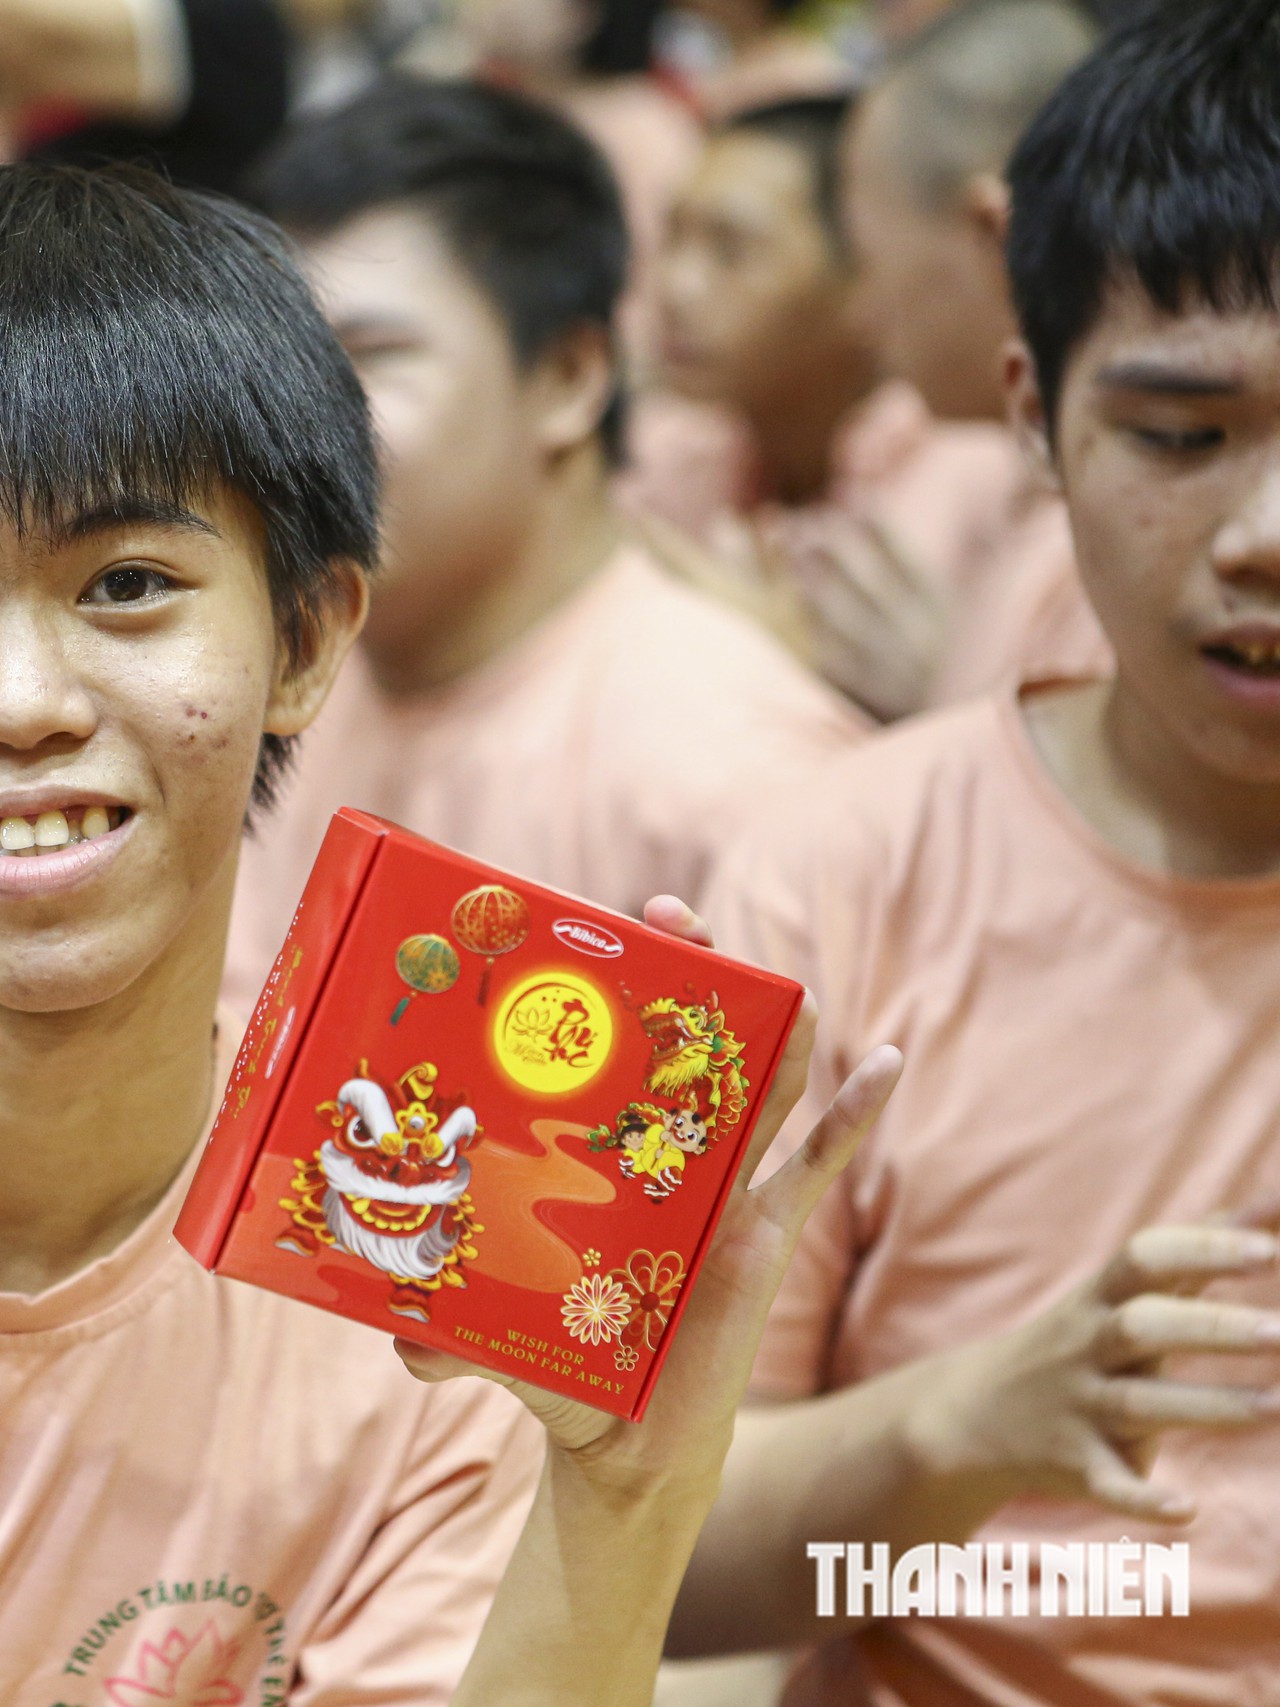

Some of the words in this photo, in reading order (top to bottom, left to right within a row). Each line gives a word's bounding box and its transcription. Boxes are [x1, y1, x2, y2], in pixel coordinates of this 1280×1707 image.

[569, 925, 607, 949] Bibica
[453, 1325, 485, 1346] THE
[487, 1338, 538, 1365] MOON
[540, 1356, 573, 1377] FAR
[575, 1371, 625, 1395] AWAY
[506, 1328, 549, 1353] WISH
[551, 1345, 585, 1366] FOR
[63, 1600, 140, 1677] TRUNG
